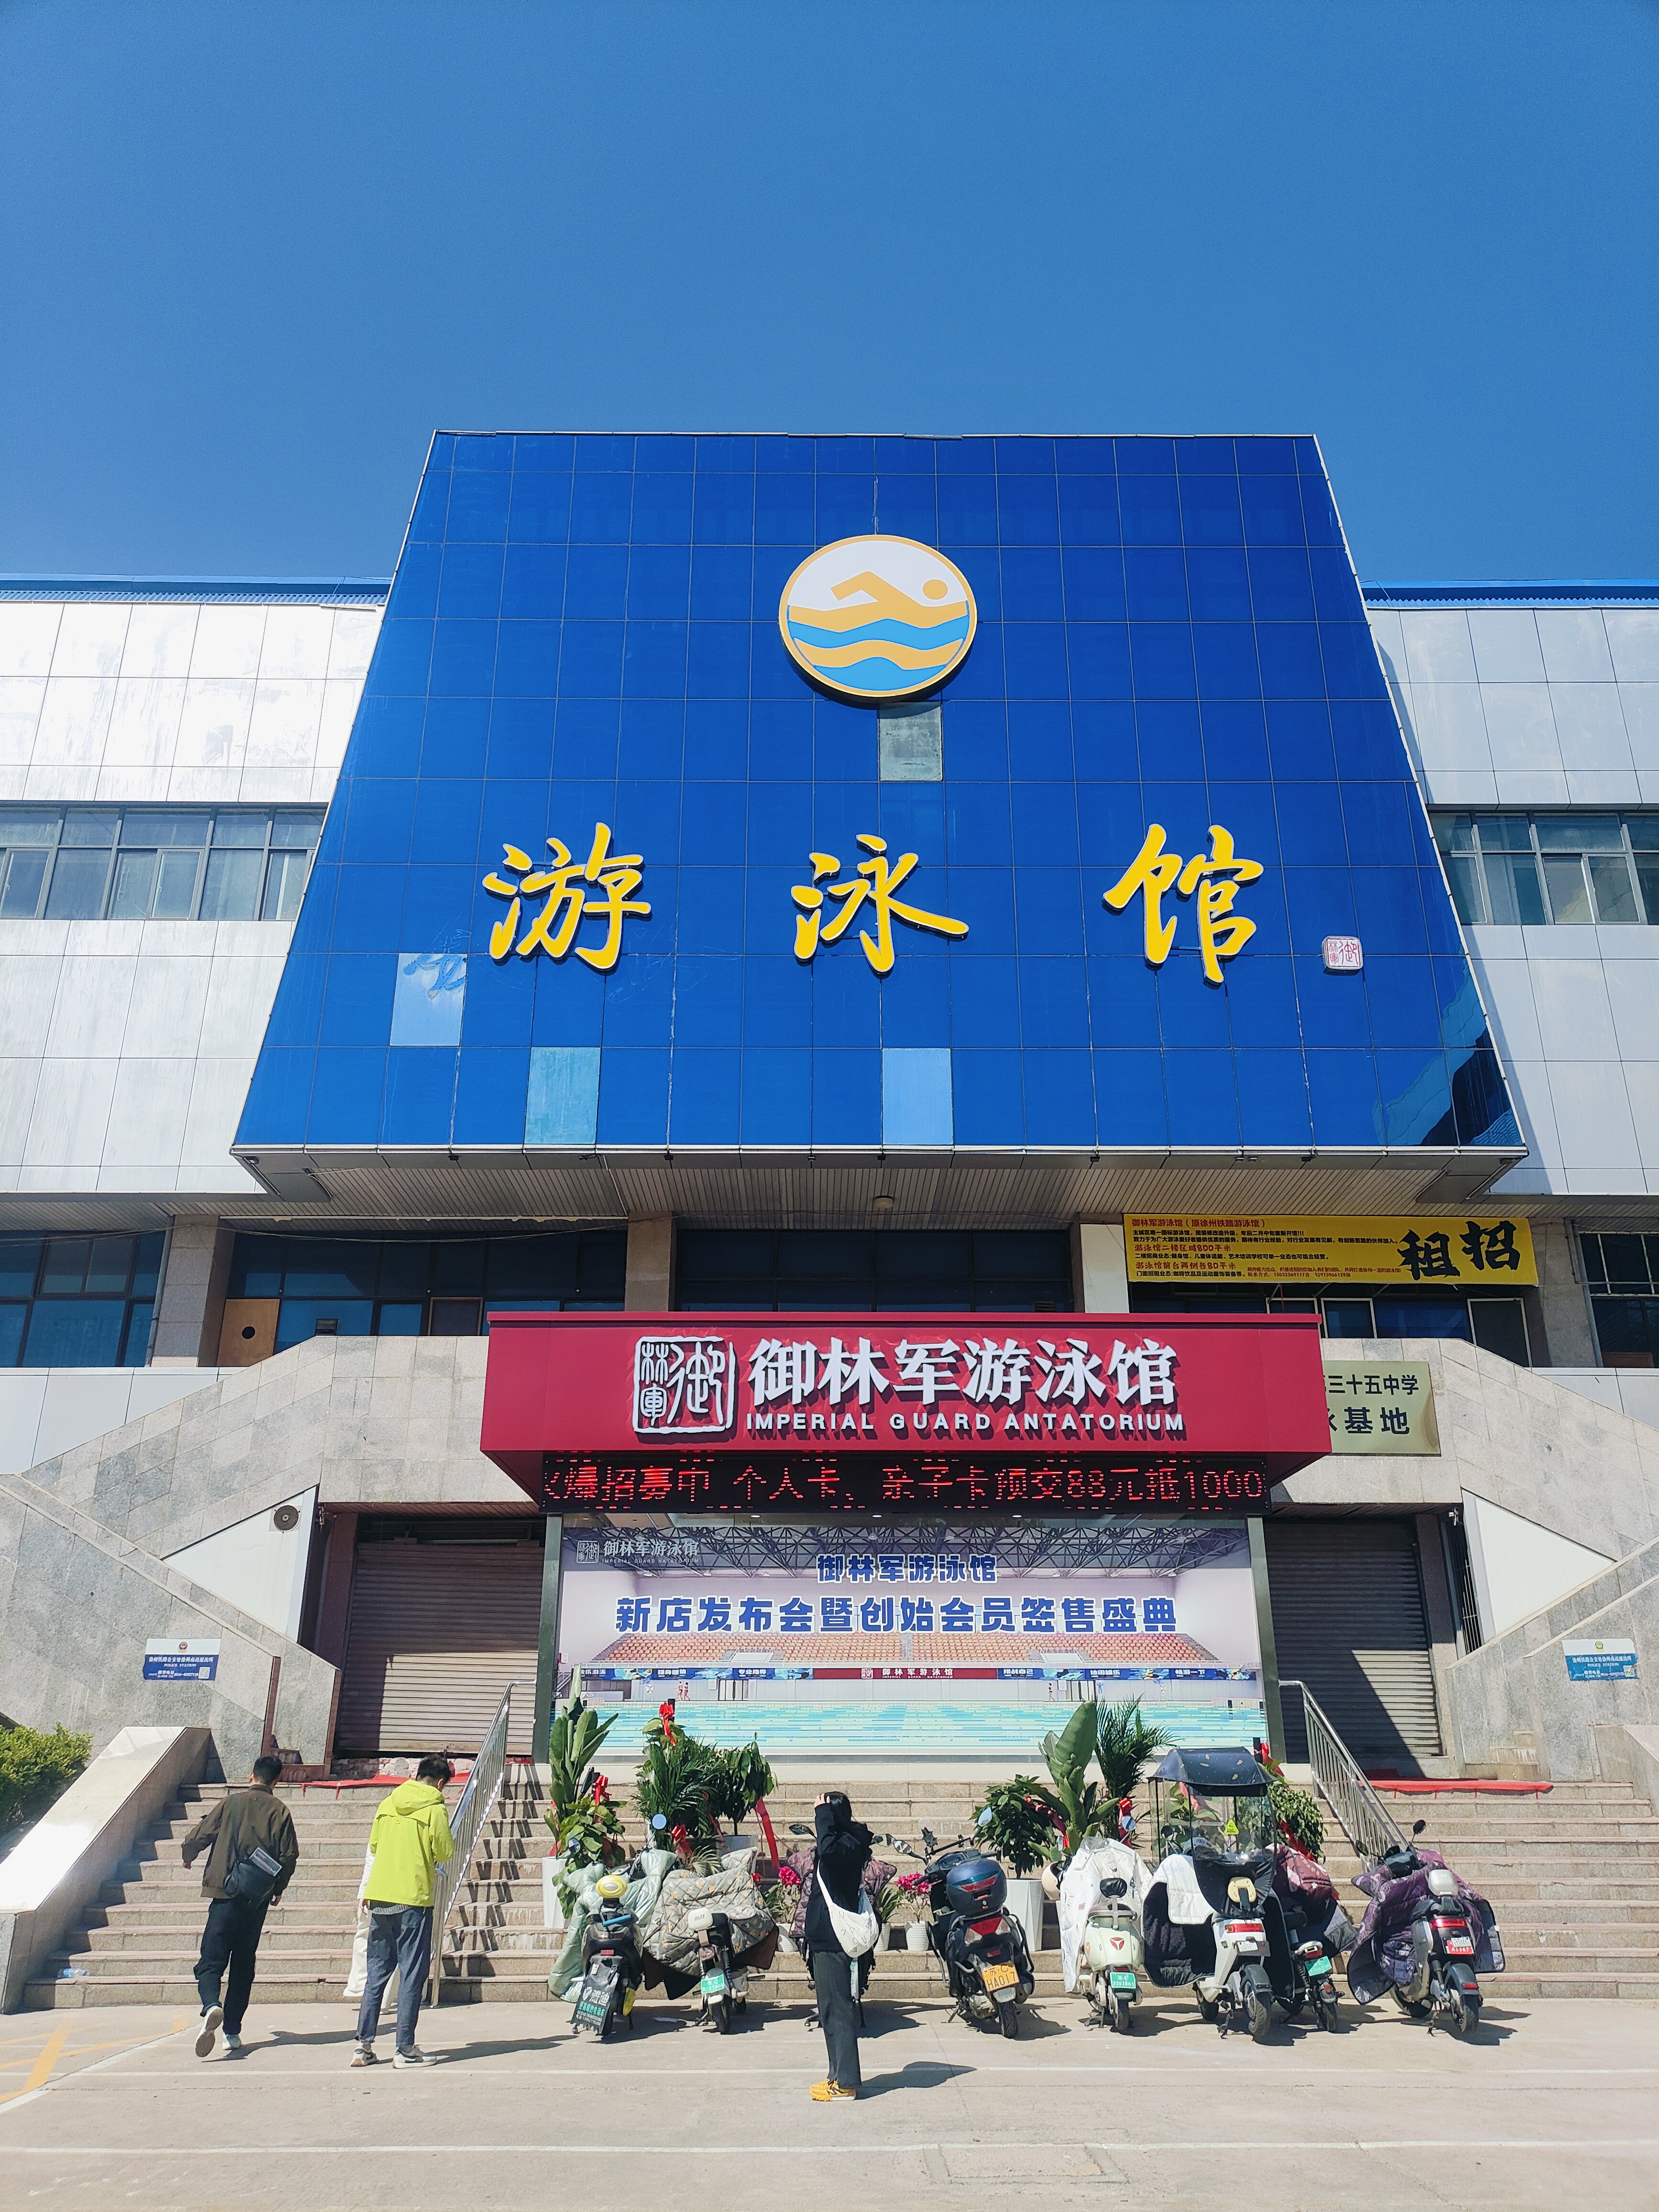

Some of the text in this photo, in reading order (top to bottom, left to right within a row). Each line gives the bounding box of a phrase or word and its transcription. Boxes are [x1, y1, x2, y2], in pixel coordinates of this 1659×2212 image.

[482, 822, 1263, 985] 游泳馆
[1134, 1244, 1231, 1252] 游泳馆二楼区域800平米
[1136, 1261, 1237, 1270] 游泳馆前台两侧各80平米
[747, 1337, 1177, 1405] 御林军游泳馆
[1323, 1374, 1419, 1395] 三十五中学
[747, 1413, 1184, 1431] IMPERIAL GUARD ANTATORIUM
[603, 1540, 699, 1557] 御林军游泳馆
[817, 1554, 997, 1582] 御林军游泳馆
[616, 1596, 1177, 1633] 新店发布会暨创始会员签售盛典
[589, 1989, 610, 2006] 雅迪
